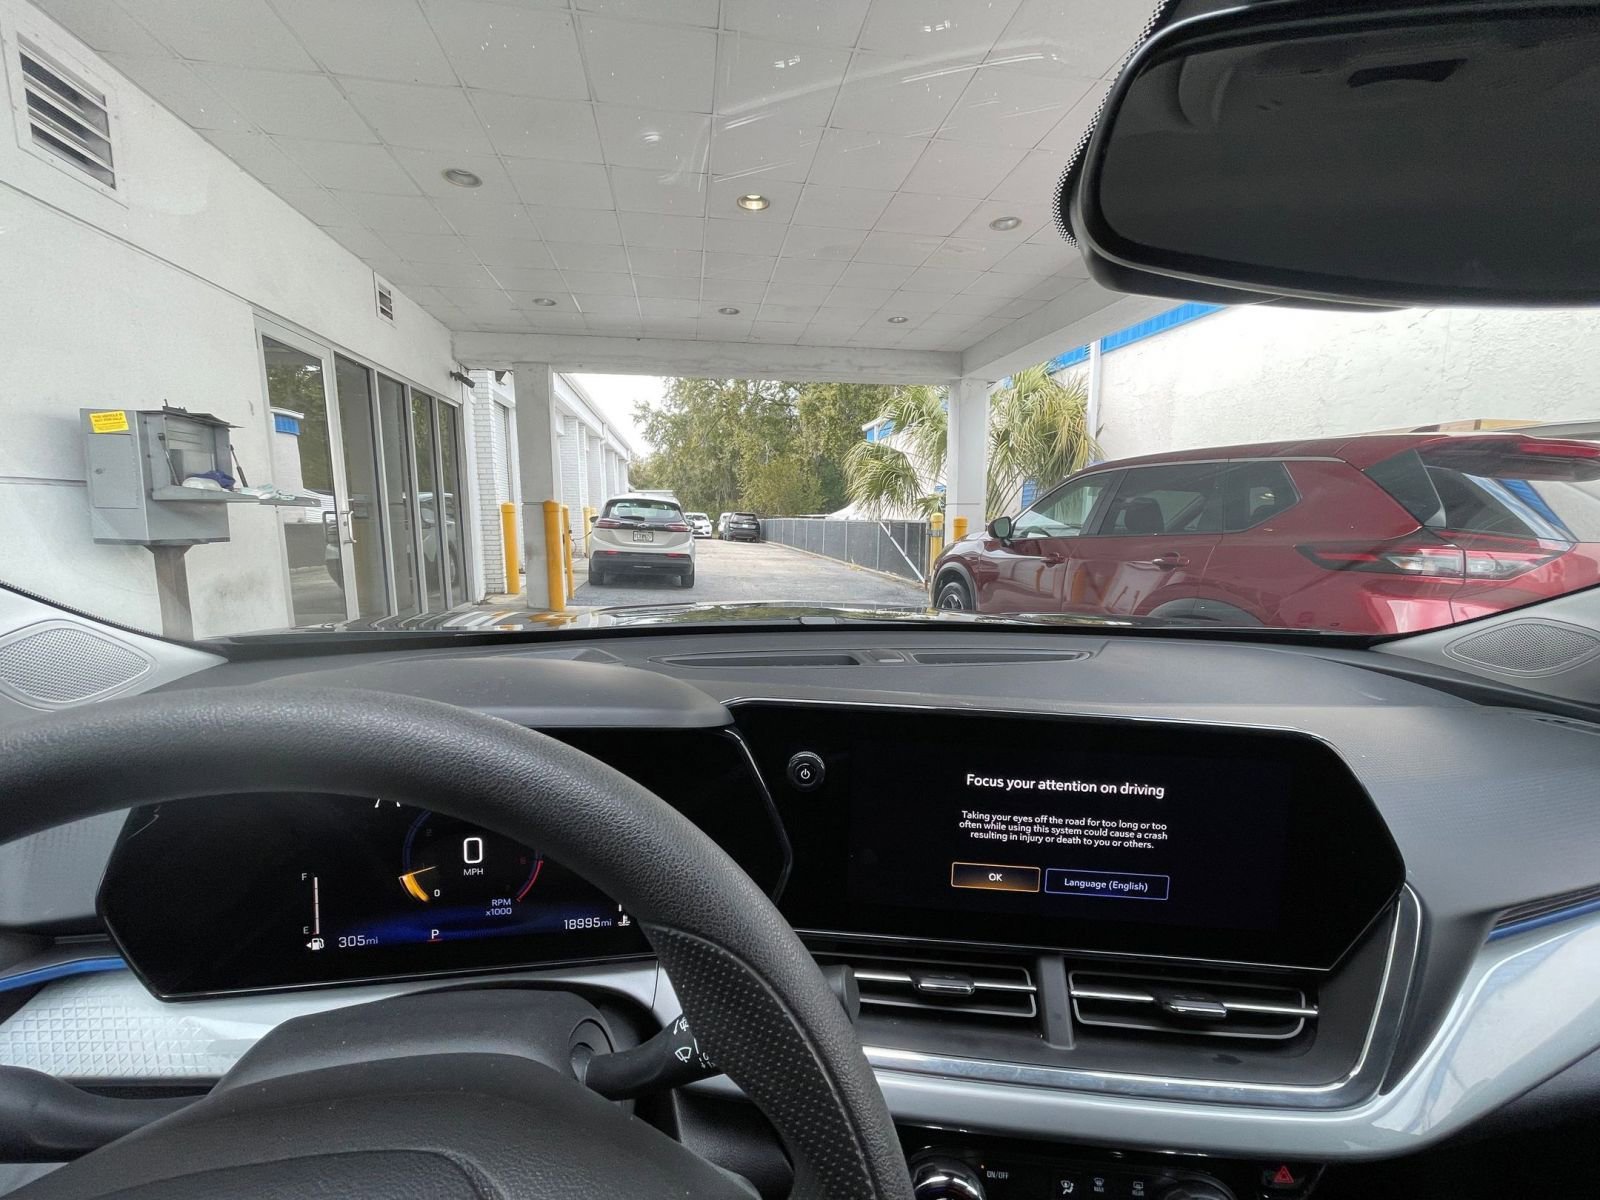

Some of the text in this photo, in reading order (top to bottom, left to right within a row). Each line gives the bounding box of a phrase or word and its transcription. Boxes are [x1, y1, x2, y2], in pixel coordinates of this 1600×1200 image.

[966, 773, 1165, 799] Focus your attention on driving
[961, 810, 1168, 831] Taking your eyes off the road for too long or too
[958, 819, 982, 829] often
[983, 821, 1007, 831] while
[1008, 823, 1032, 834] using
[1033, 824, 1050, 834] this
[1050, 826, 1082, 836] system
[1083, 827, 1108, 837] could
[1109, 830, 1135, 838] cause
[1143, 831, 1168, 840] crash
[970, 830, 1008, 842] resulting
[1009, 832, 1018, 841] in
[1019, 832, 1044, 844] injury
[1056, 834, 1081, 845] death
[1083, 837, 1093, 846] to
[1093, 839, 1110, 848] you
[1123, 839, 1154, 849] others.
[463, 837, 483, 864] 0
[301, 872, 308, 881] F
[463, 867, 484, 877] MPH
[988, 872, 1003, 882] OK
[1064, 877, 1148, 893] Language (English)
[491, 898, 512, 907] RPM
[485, 907, 513, 916] x1000
[303, 926, 309, 934] E
[431, 929, 440, 940] P
[986, 1170, 1009, 1180] ON/OFF
